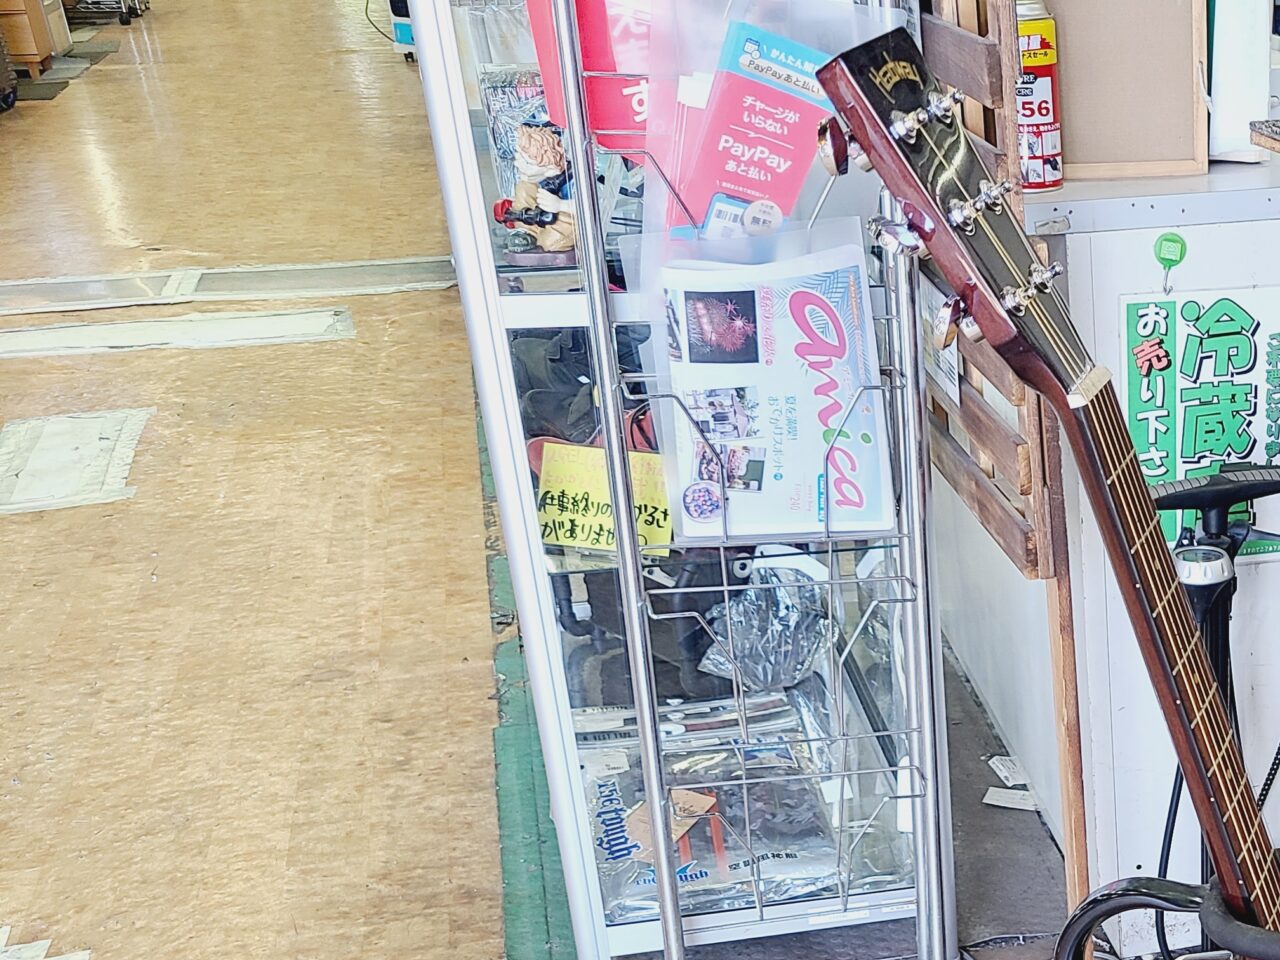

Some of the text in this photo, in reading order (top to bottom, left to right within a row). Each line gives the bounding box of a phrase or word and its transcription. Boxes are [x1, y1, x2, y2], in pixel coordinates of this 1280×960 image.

[747, 59, 821, 94] PayPayあと払い
[742, 95, 800, 124] チャージが
[743, 111, 789, 135] いらない
[1017, 100, 1050, 118] 56
[717, 134, 792, 173] PayPay
[724, 159, 772, 182] あと払い
[788, 290, 872, 509] amica
[1132, 303, 1169, 482] お売り下さ
[768, 396, 784, 473] おでかけスポット
